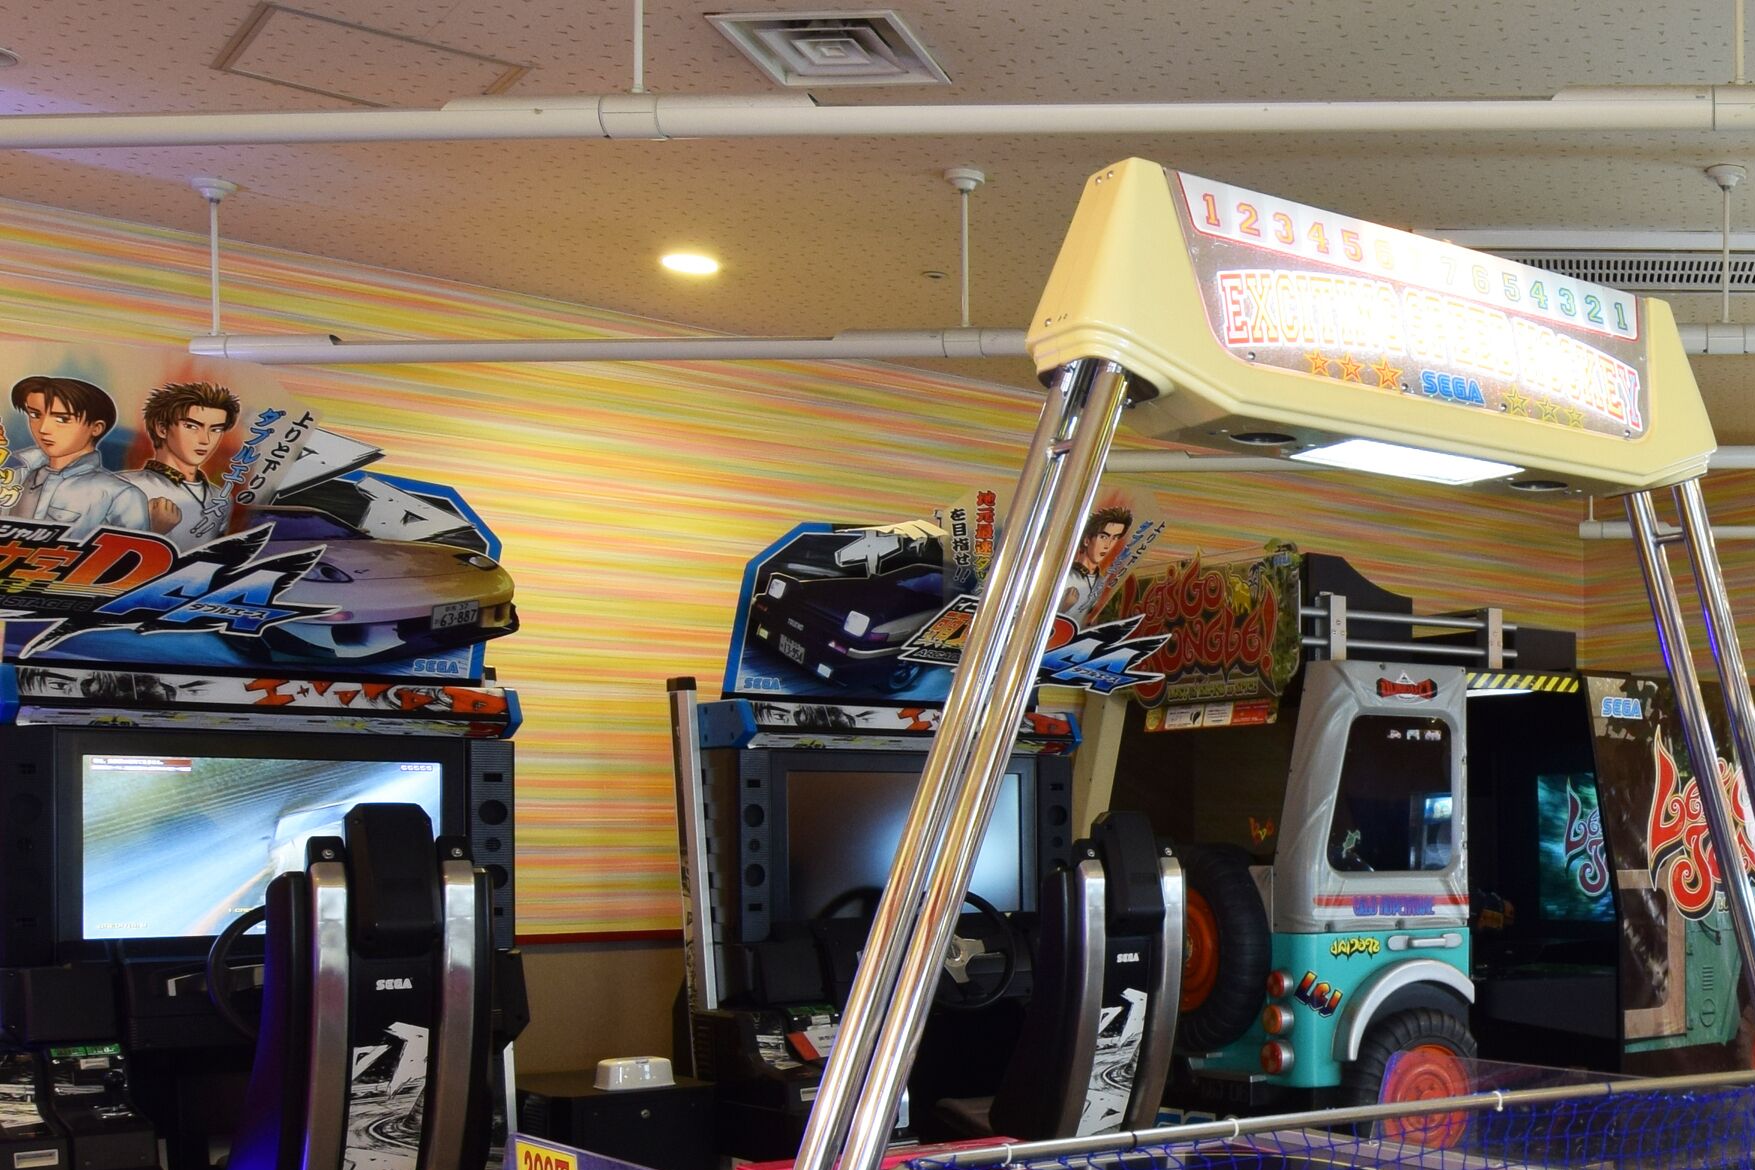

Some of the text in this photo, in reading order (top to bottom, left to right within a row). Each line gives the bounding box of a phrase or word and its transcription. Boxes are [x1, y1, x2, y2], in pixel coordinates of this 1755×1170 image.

[1203, 193, 1220, 227] 1
[1237, 202, 1260, 237] 2
[1273, 212, 1294, 244] 3
[1308, 222, 1329, 254] 4
[1341, 229, 1363, 262] 5
[1472, 264, 1489, 293] 6
[1502, 272, 1520, 302] 5
[1530, 281, 1548, 309] 4
[1559, 287, 1576, 316] 3
[1584, 294, 1604, 324] 2
[1615, 302, 1628, 331] 1
[1420, 369, 1485, 405] SEGA
[413, 659, 460, 674] SEGA
[743, 677, 782, 691] SEGA
[1601, 697, 1643, 720] SEGA
[1116, 953, 1140, 963] SEGA
[375, 978, 413, 991] SEGA
